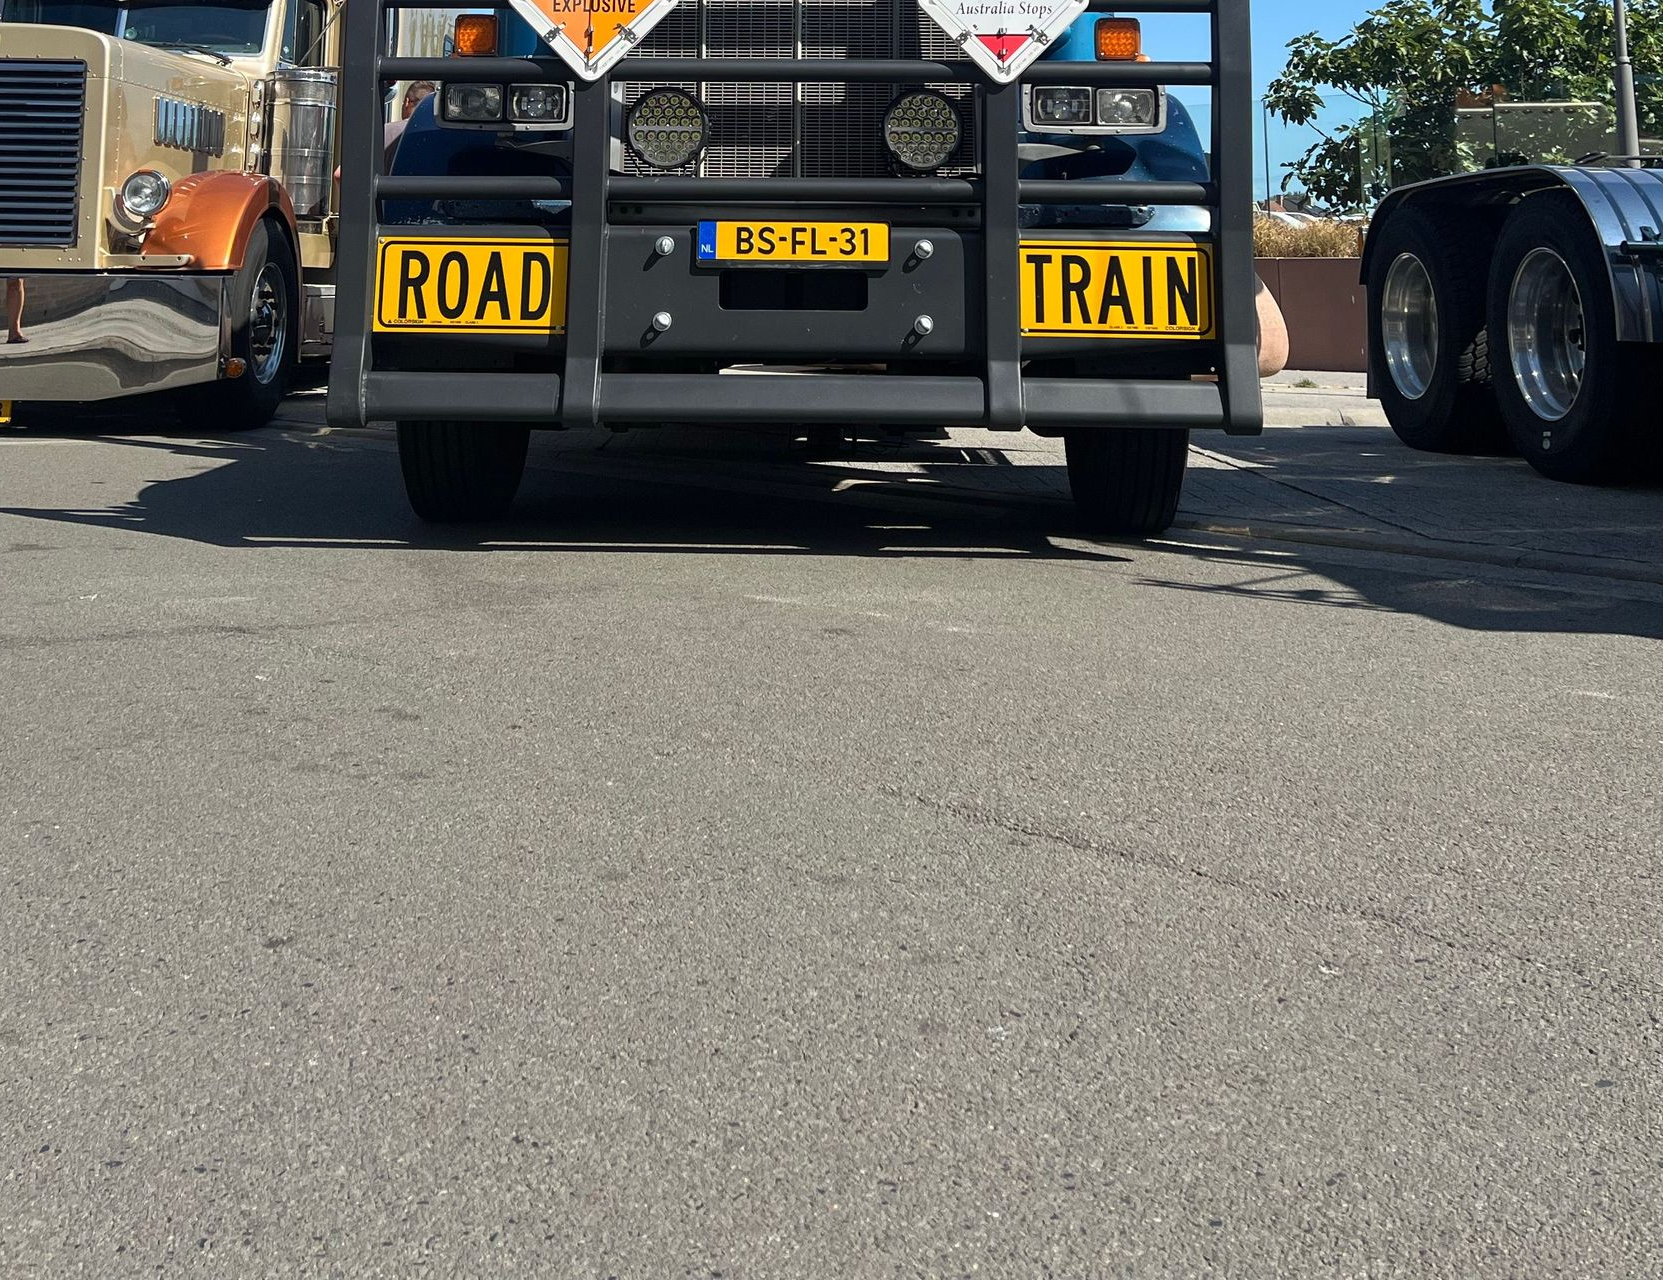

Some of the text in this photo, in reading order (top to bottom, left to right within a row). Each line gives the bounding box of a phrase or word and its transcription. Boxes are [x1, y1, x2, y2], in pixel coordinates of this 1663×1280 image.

[955, 1, 1052, 18] Australia Stops
[701, 226, 869, 256] NL BS-FL-31
[398, 250, 552, 321] ROAD
[1026, 254, 1198, 326] TRAIN
